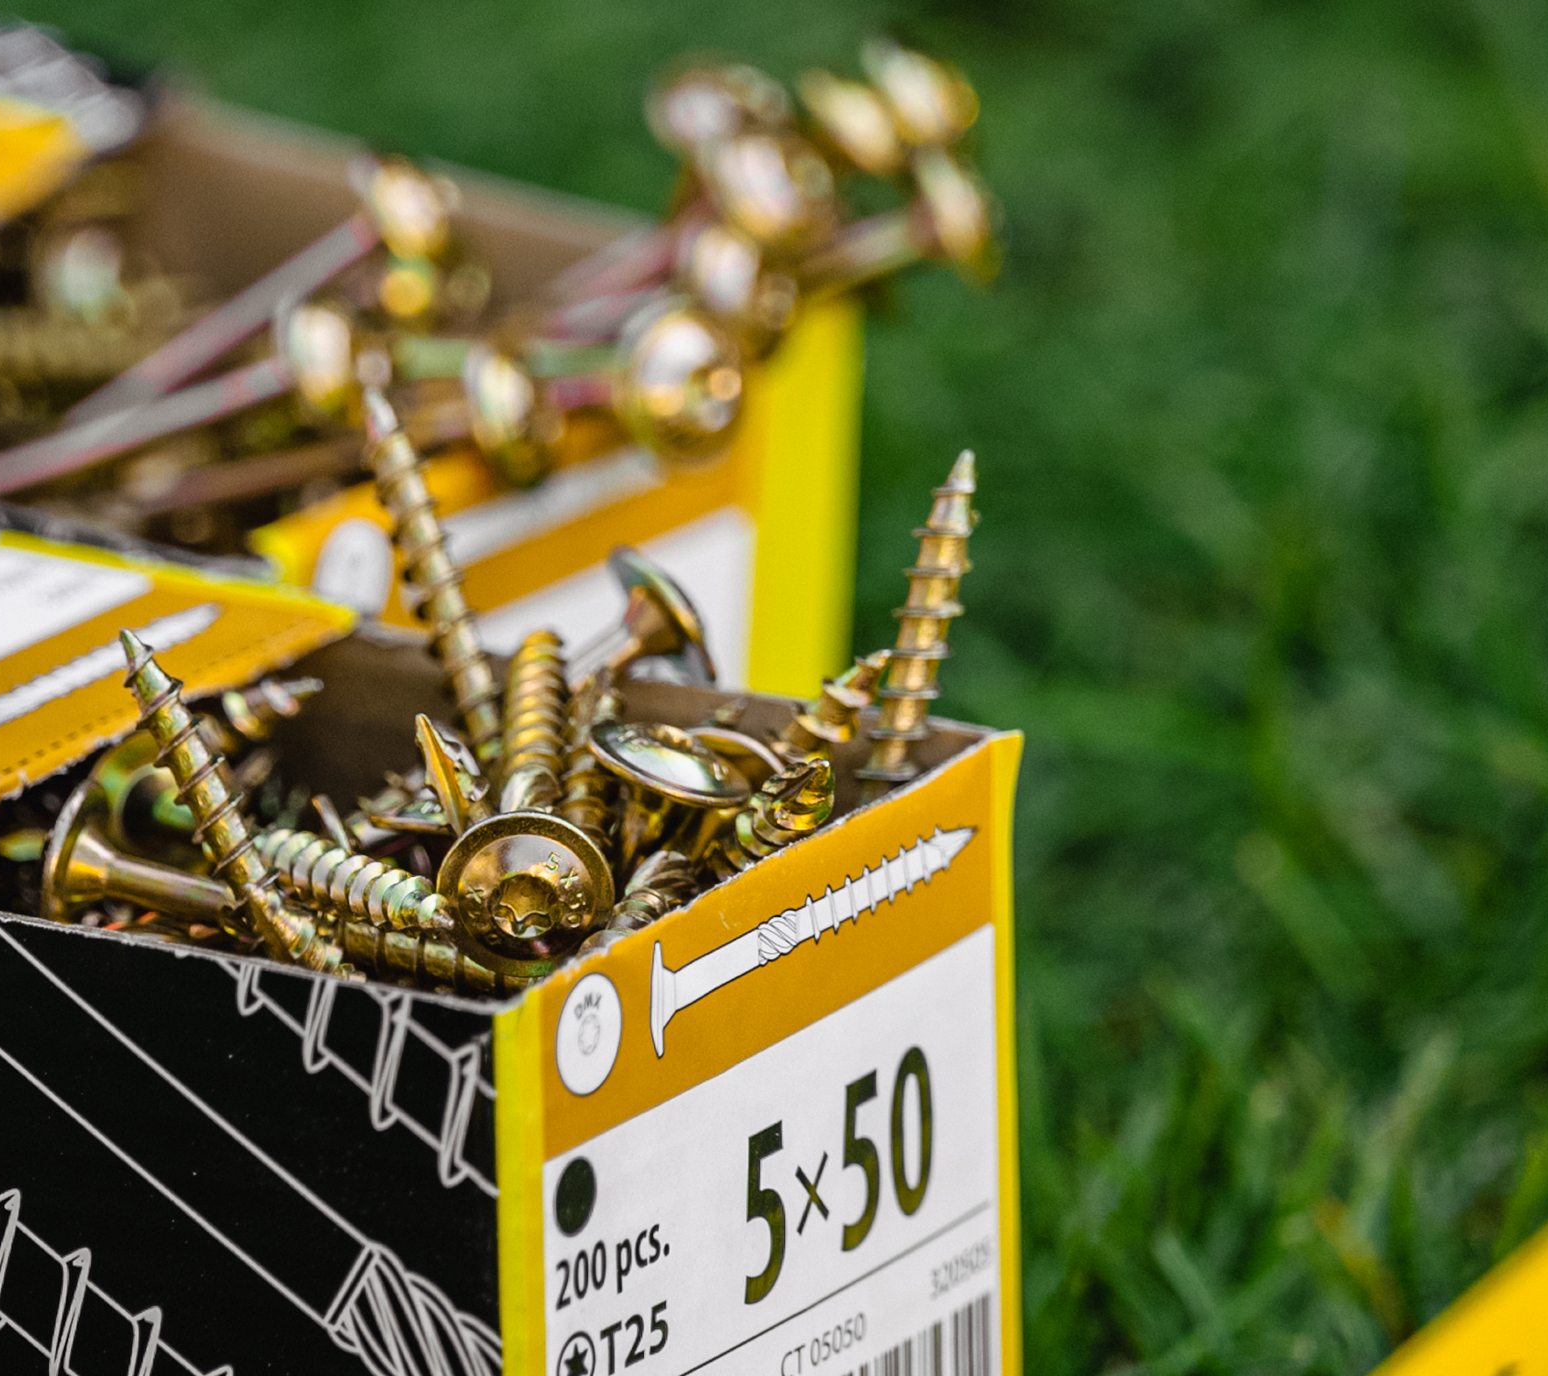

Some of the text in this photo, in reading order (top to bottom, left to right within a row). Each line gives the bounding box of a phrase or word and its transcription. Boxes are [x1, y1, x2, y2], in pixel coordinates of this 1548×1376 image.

[573, 992, 603, 1021] DMX
[555, 1223, 671, 1311] 200 pcs.
[600, 1300, 669, 1376] T25
[809, 1312, 868, 1367] 05050
